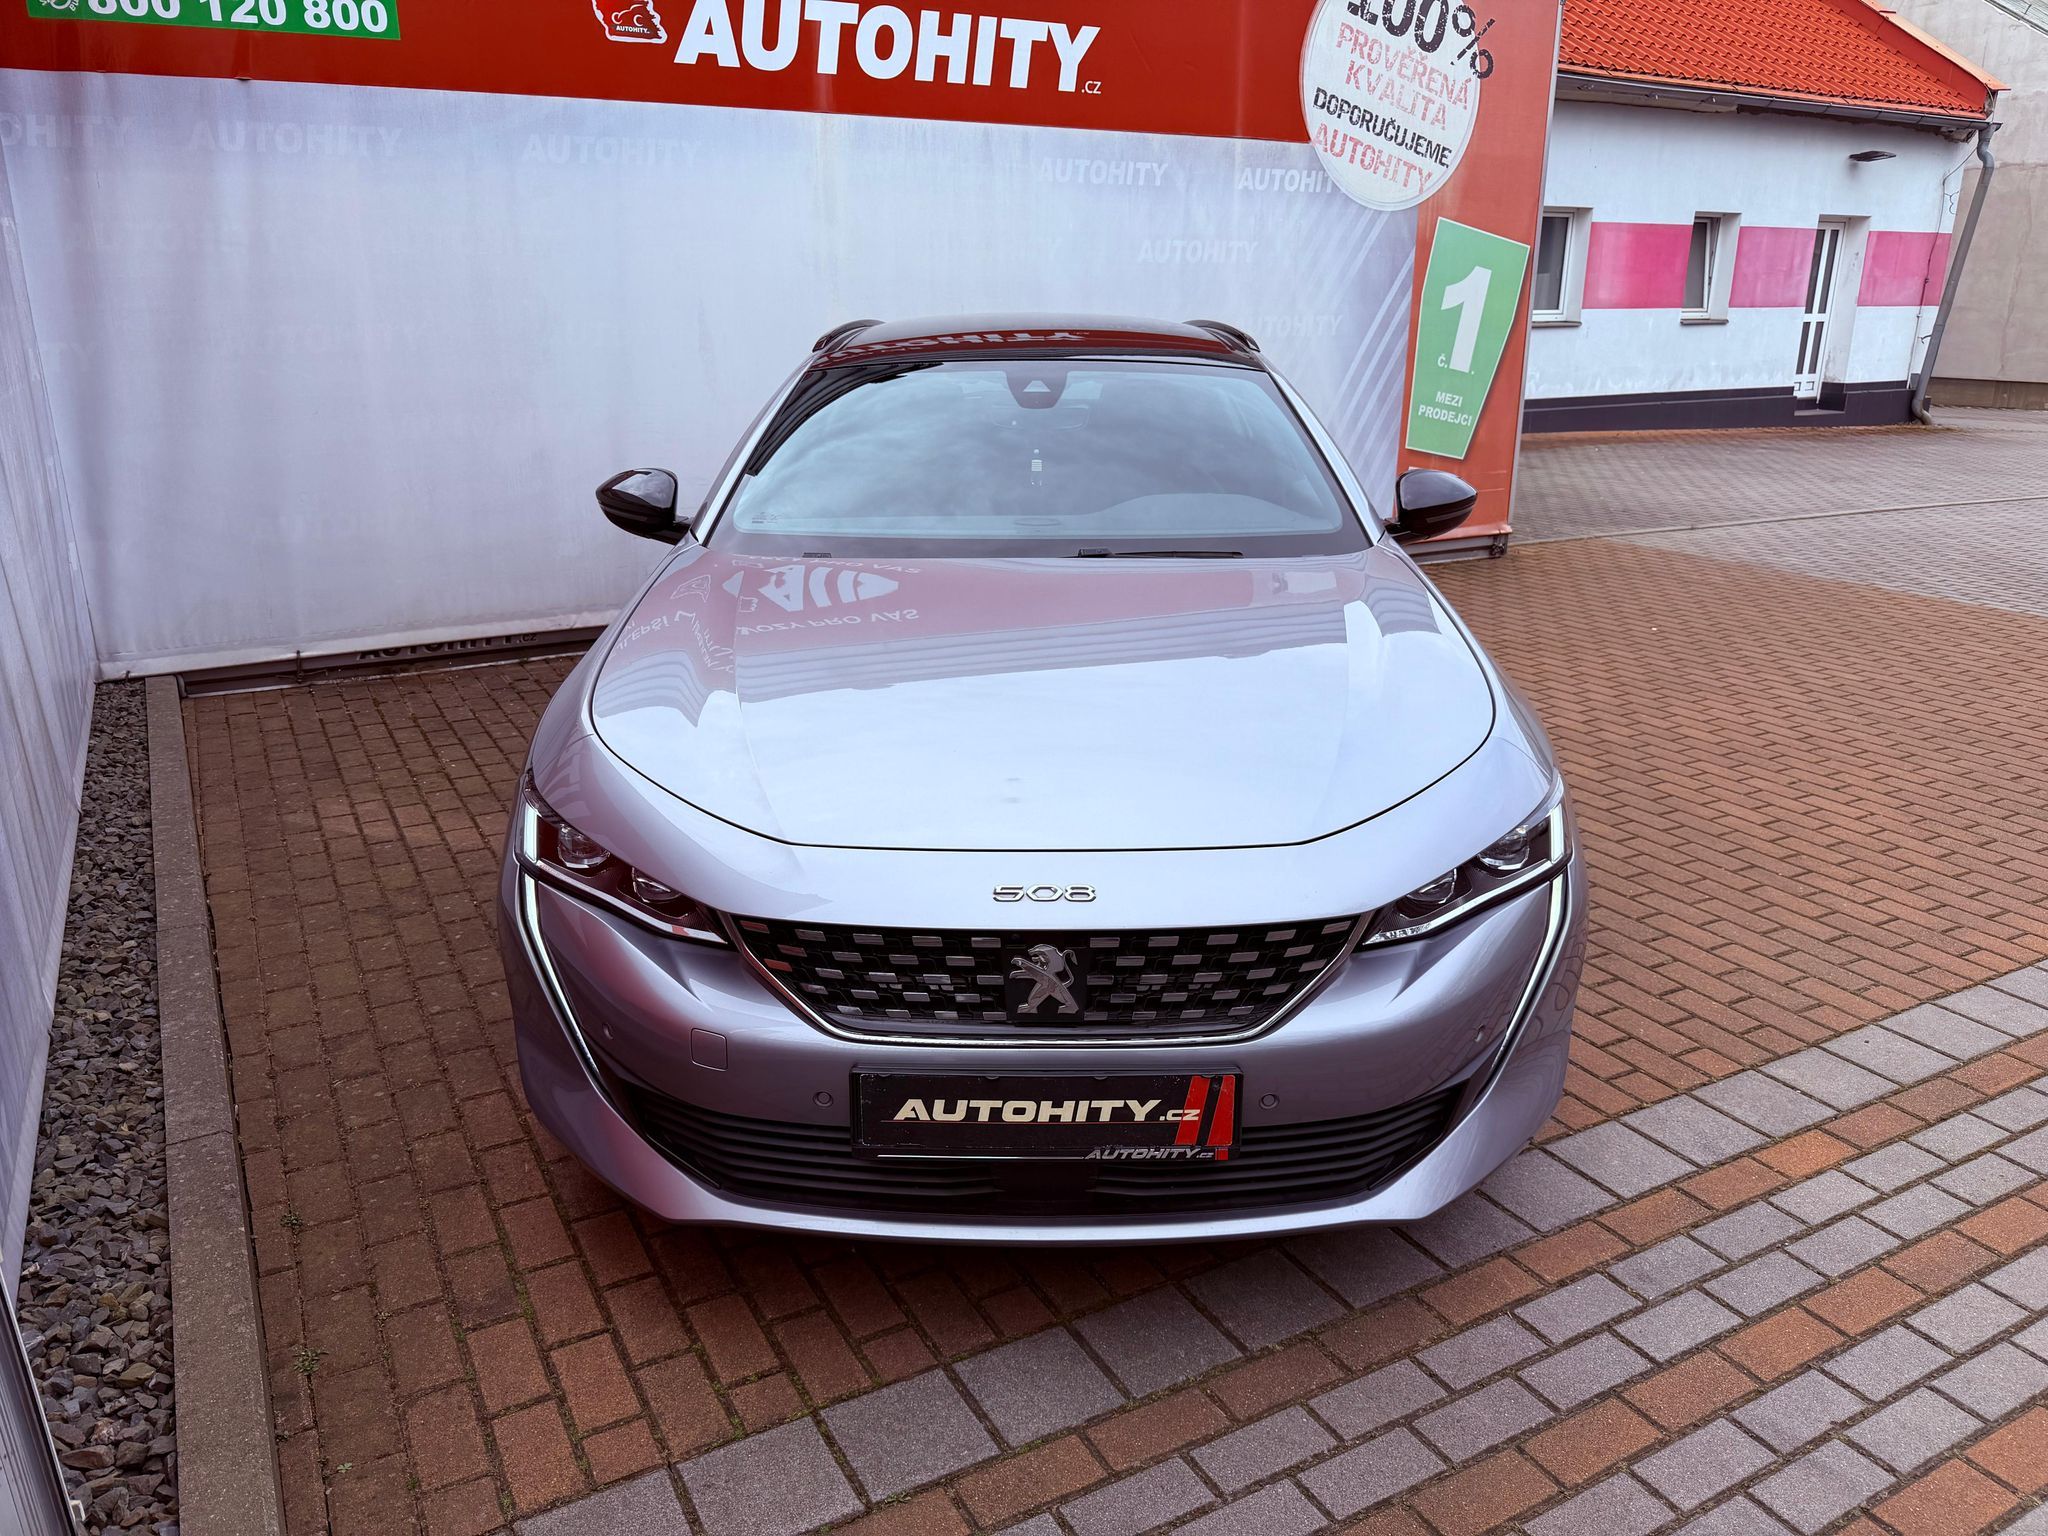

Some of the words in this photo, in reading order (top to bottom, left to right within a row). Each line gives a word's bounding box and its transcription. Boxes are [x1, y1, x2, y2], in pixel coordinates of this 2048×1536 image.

[200, 0, 287, 26] 120
[303, 0, 388, 33] 800
[1336, 22, 1473, 110] PROVĚŘENÁ
[1345, 60, 1447, 131] KVALITA
[1313, 87, 1453, 168] DOPORUČUJEME
[1040, 156, 1169, 187] AUTOHITY
[1312, 122, 1434, 194] AUTOHITY
[1137, 240, 1258, 265] AUTOHITY
[1435, 391, 1464, 407] MEZI
[1418, 404, 1472, 427] PRODEJCI
[993, 884, 1096, 902] 508
